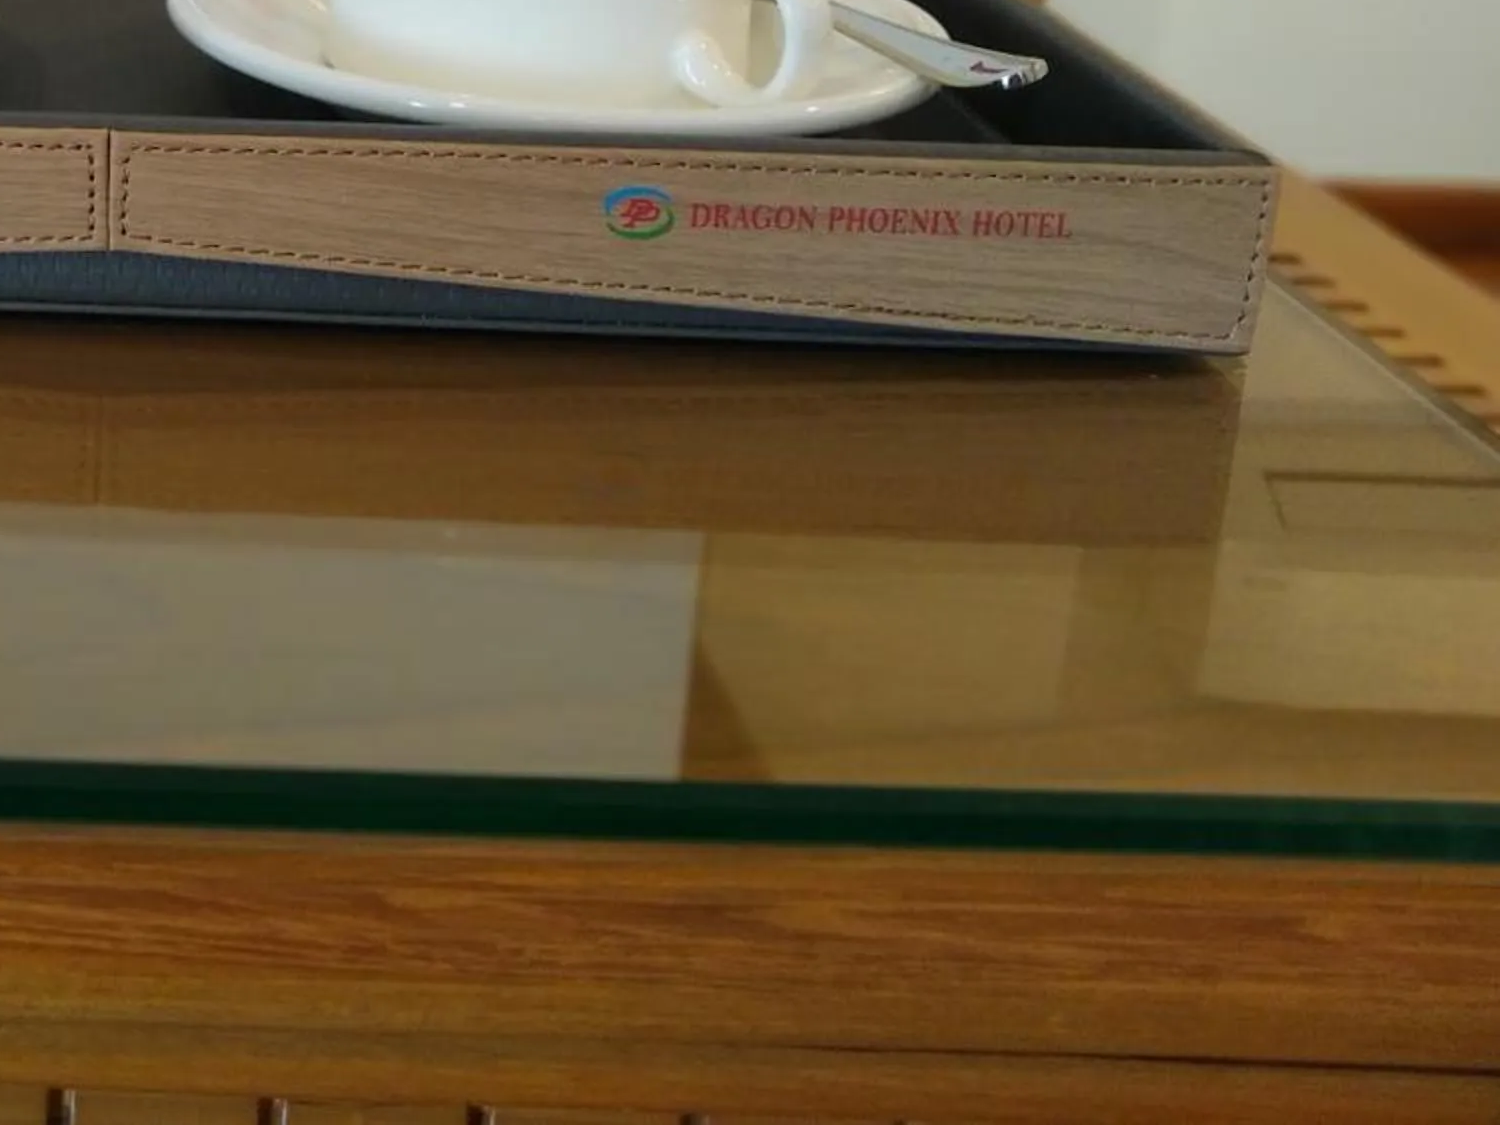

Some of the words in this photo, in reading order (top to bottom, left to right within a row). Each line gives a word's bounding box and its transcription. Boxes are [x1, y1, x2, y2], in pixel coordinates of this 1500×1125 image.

[690, 202, 818, 232] DRAGON
[828, 206, 962, 236] PHOENIX
[972, 210, 1073, 239] HOTEL
